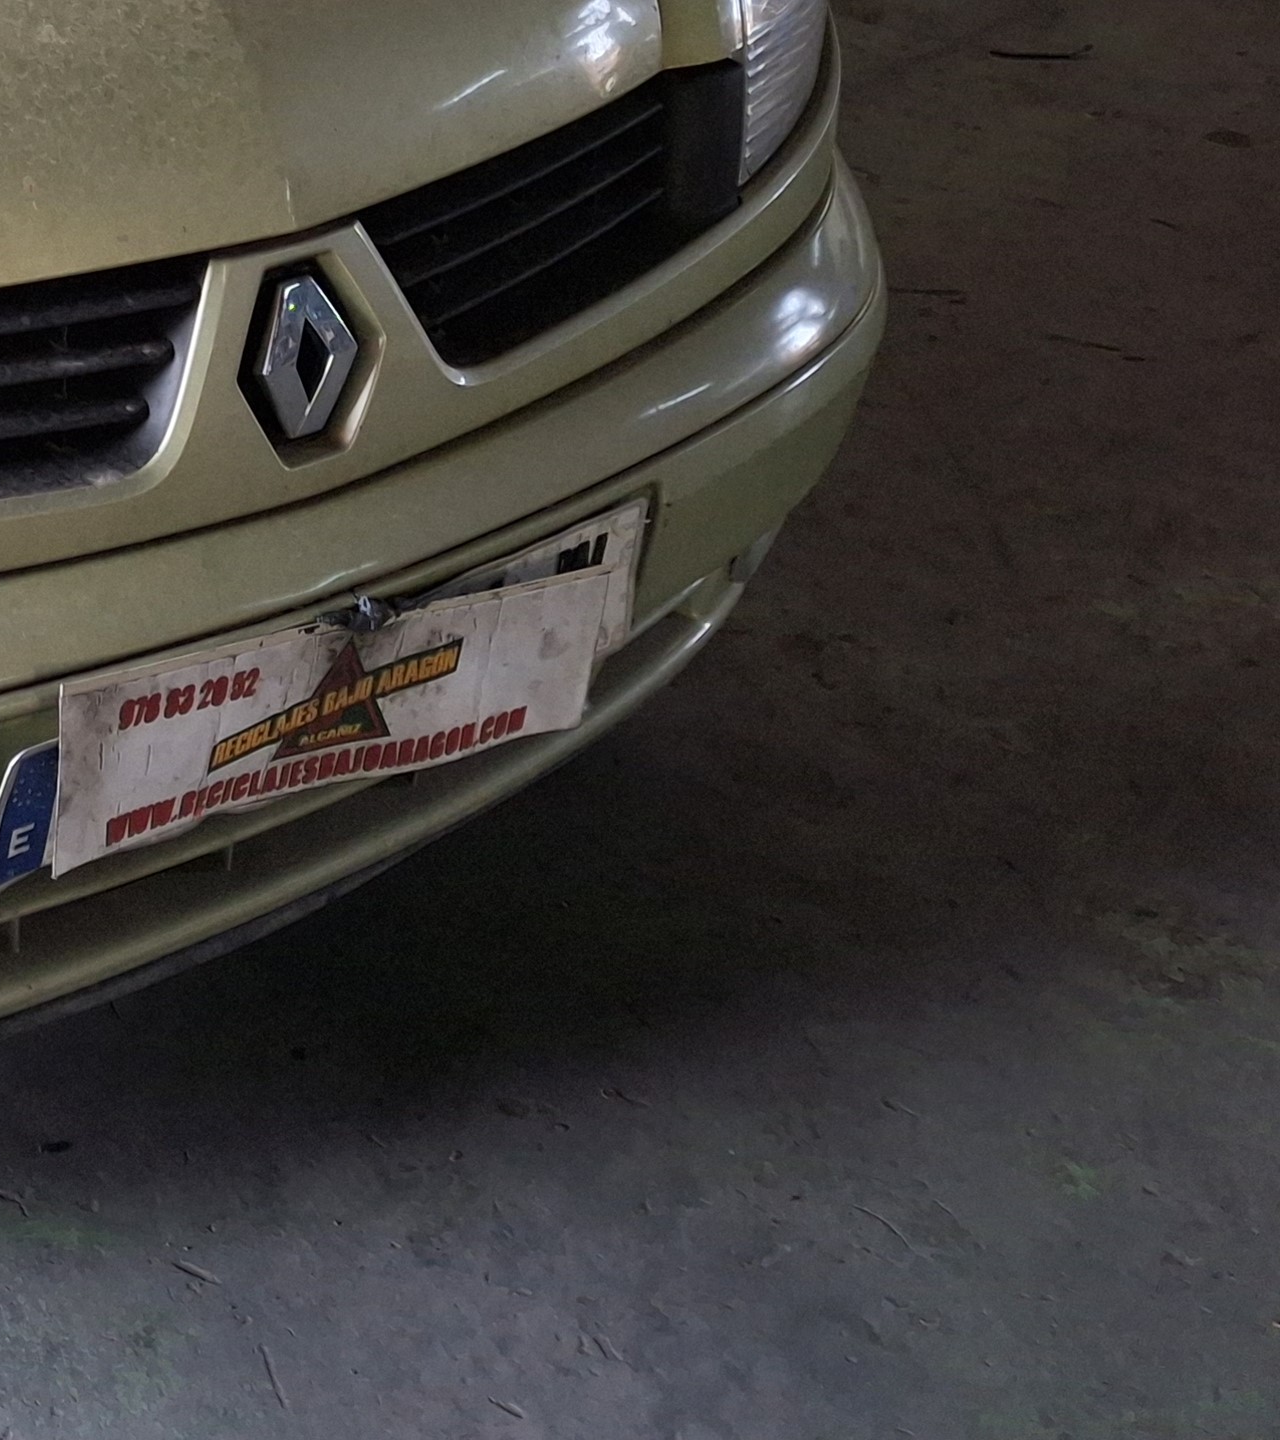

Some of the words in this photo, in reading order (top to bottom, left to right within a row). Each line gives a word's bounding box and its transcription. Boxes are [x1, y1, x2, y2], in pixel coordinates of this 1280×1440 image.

[230, 667, 261, 701] 52
[211, 698, 320, 767] RECICLAJES
[321, 675, 374, 717] BAJO
[7, 821, 36, 860] E
